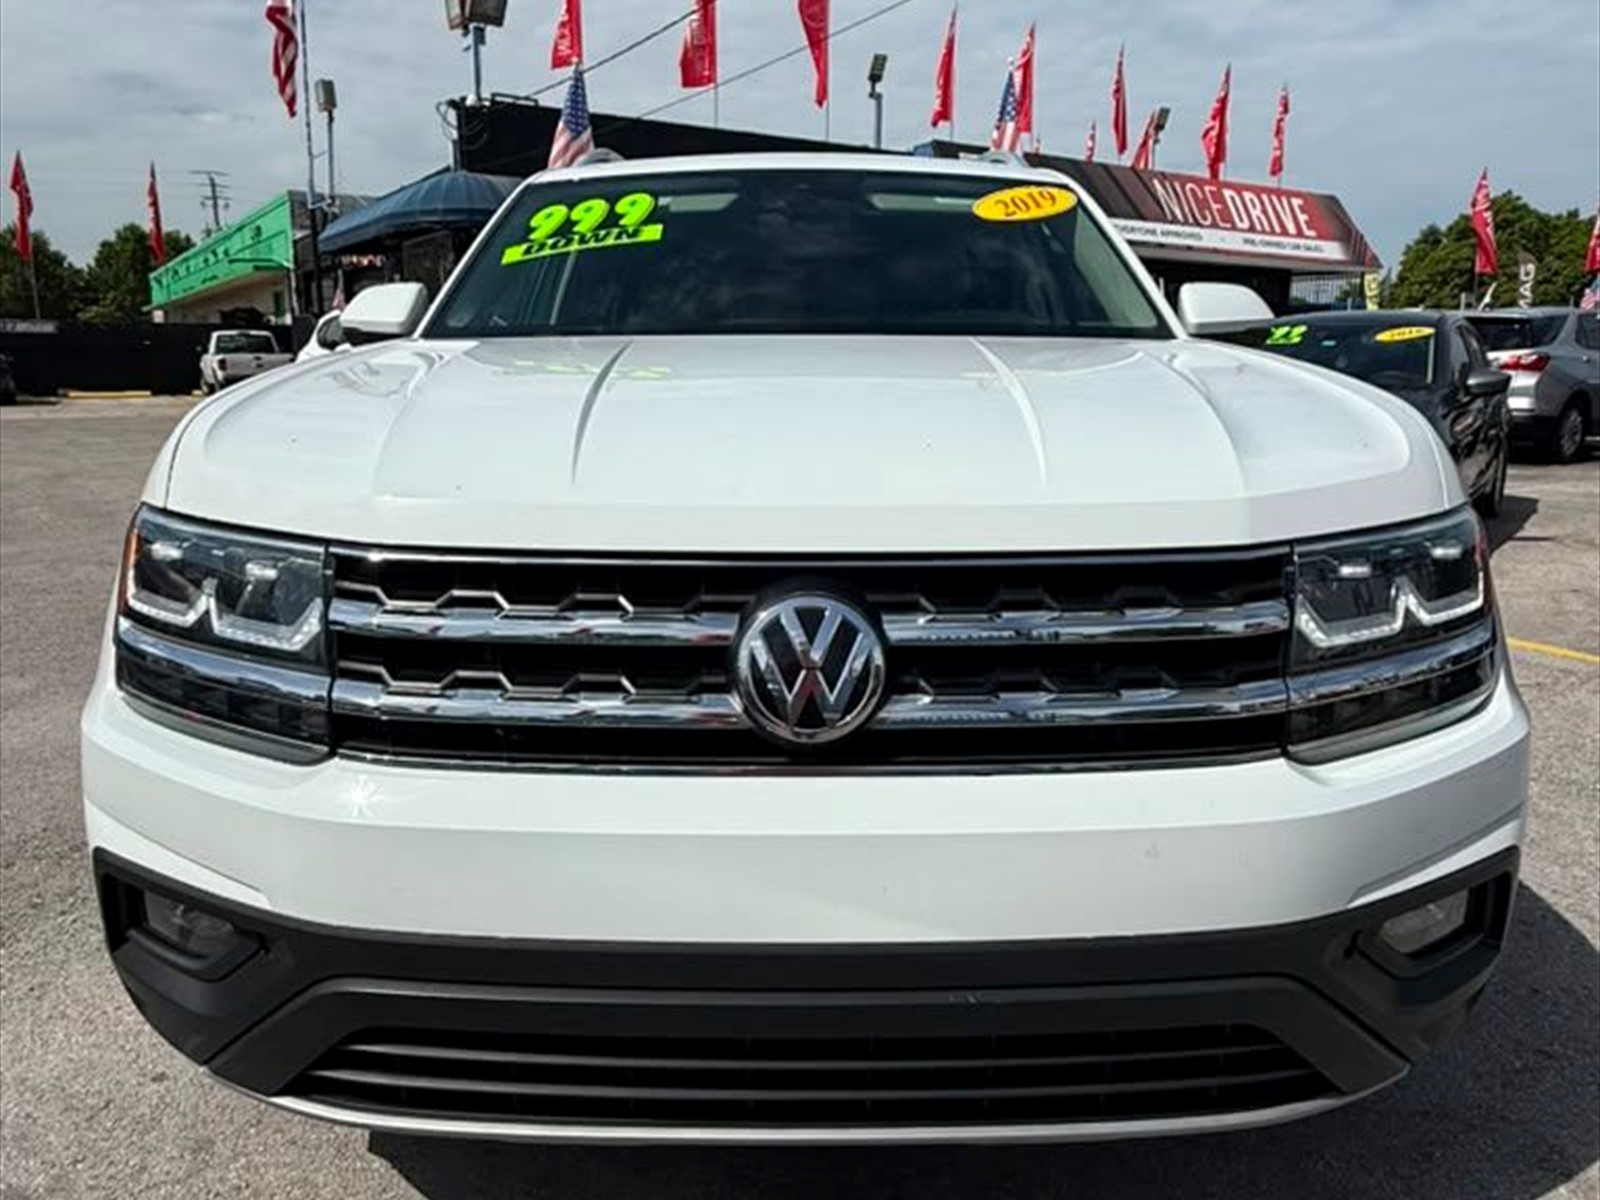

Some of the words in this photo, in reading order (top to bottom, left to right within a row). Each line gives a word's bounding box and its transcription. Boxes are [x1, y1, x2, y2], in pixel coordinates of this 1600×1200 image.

[529, 193, 655, 241] 999
[994, 189, 1057, 217] 2019
[522, 227, 641, 256] DOWN
